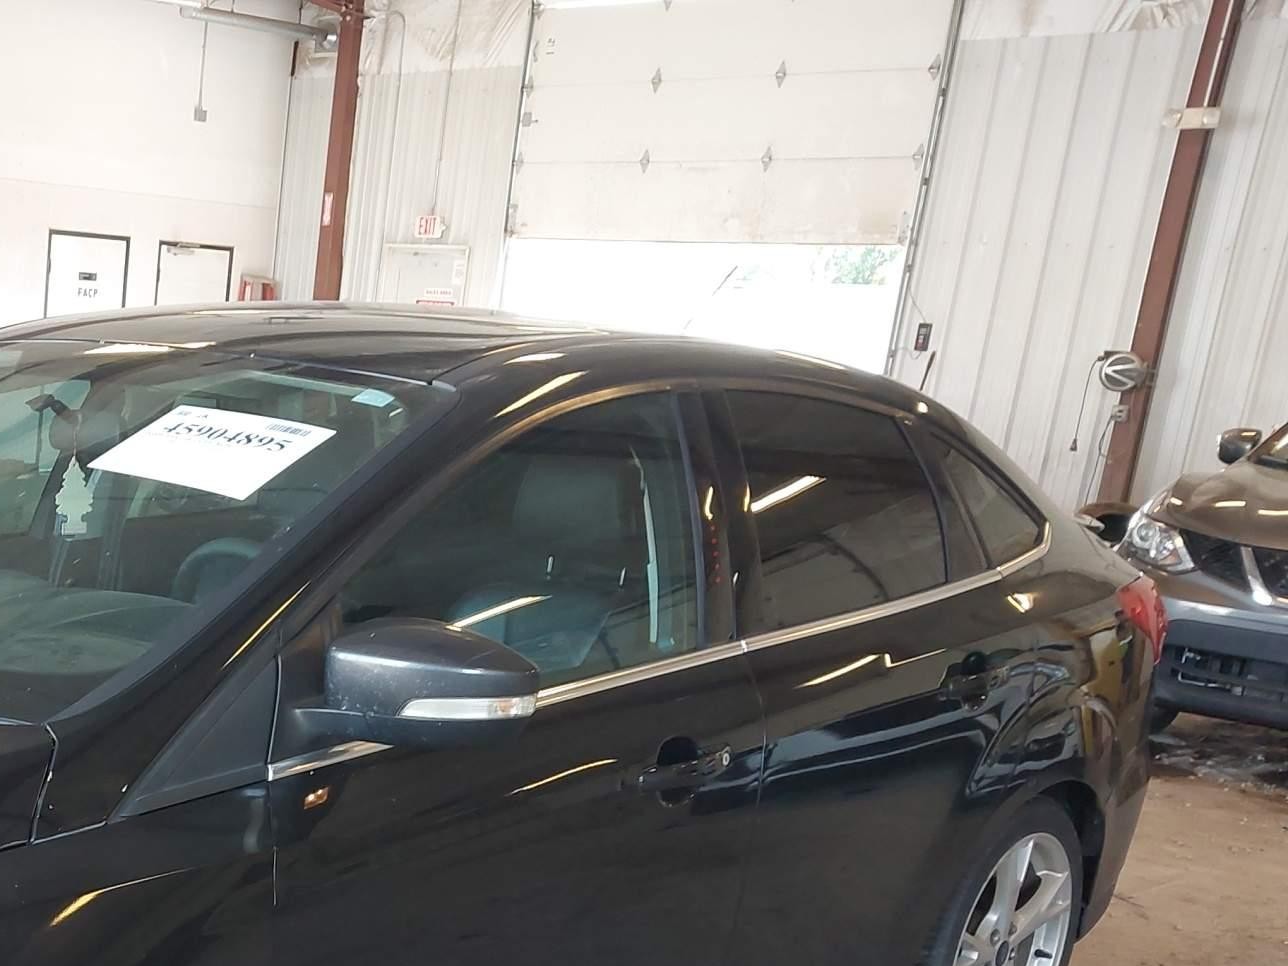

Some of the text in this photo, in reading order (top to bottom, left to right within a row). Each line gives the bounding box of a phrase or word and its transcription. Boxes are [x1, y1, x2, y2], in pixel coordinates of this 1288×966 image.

[417, 216, 437, 236] EXIT
[77, 287, 99, 299] FACP
[162, 422, 293, 451] 45904895
